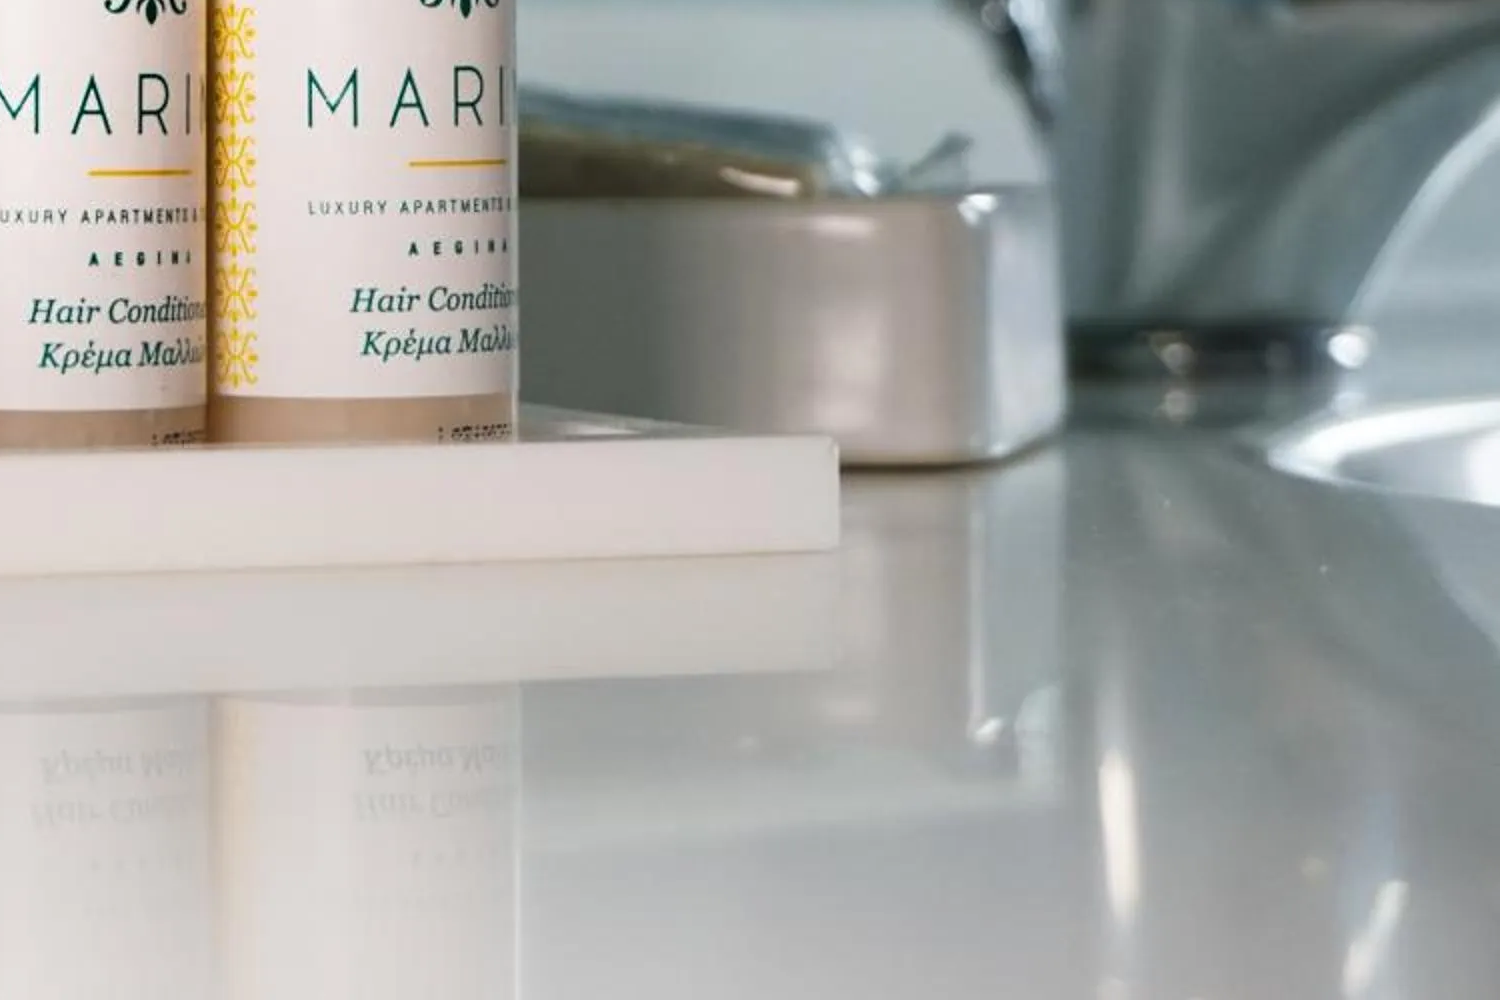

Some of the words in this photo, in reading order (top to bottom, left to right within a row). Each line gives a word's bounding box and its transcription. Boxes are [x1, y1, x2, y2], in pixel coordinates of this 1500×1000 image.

[308, 200, 388, 215] LUXURY
[27, 298, 101, 325] Hair
[349, 286, 420, 312] Hair
[38, 340, 132, 375] Κρέμα
[360, 329, 452, 361] Κρέμα
